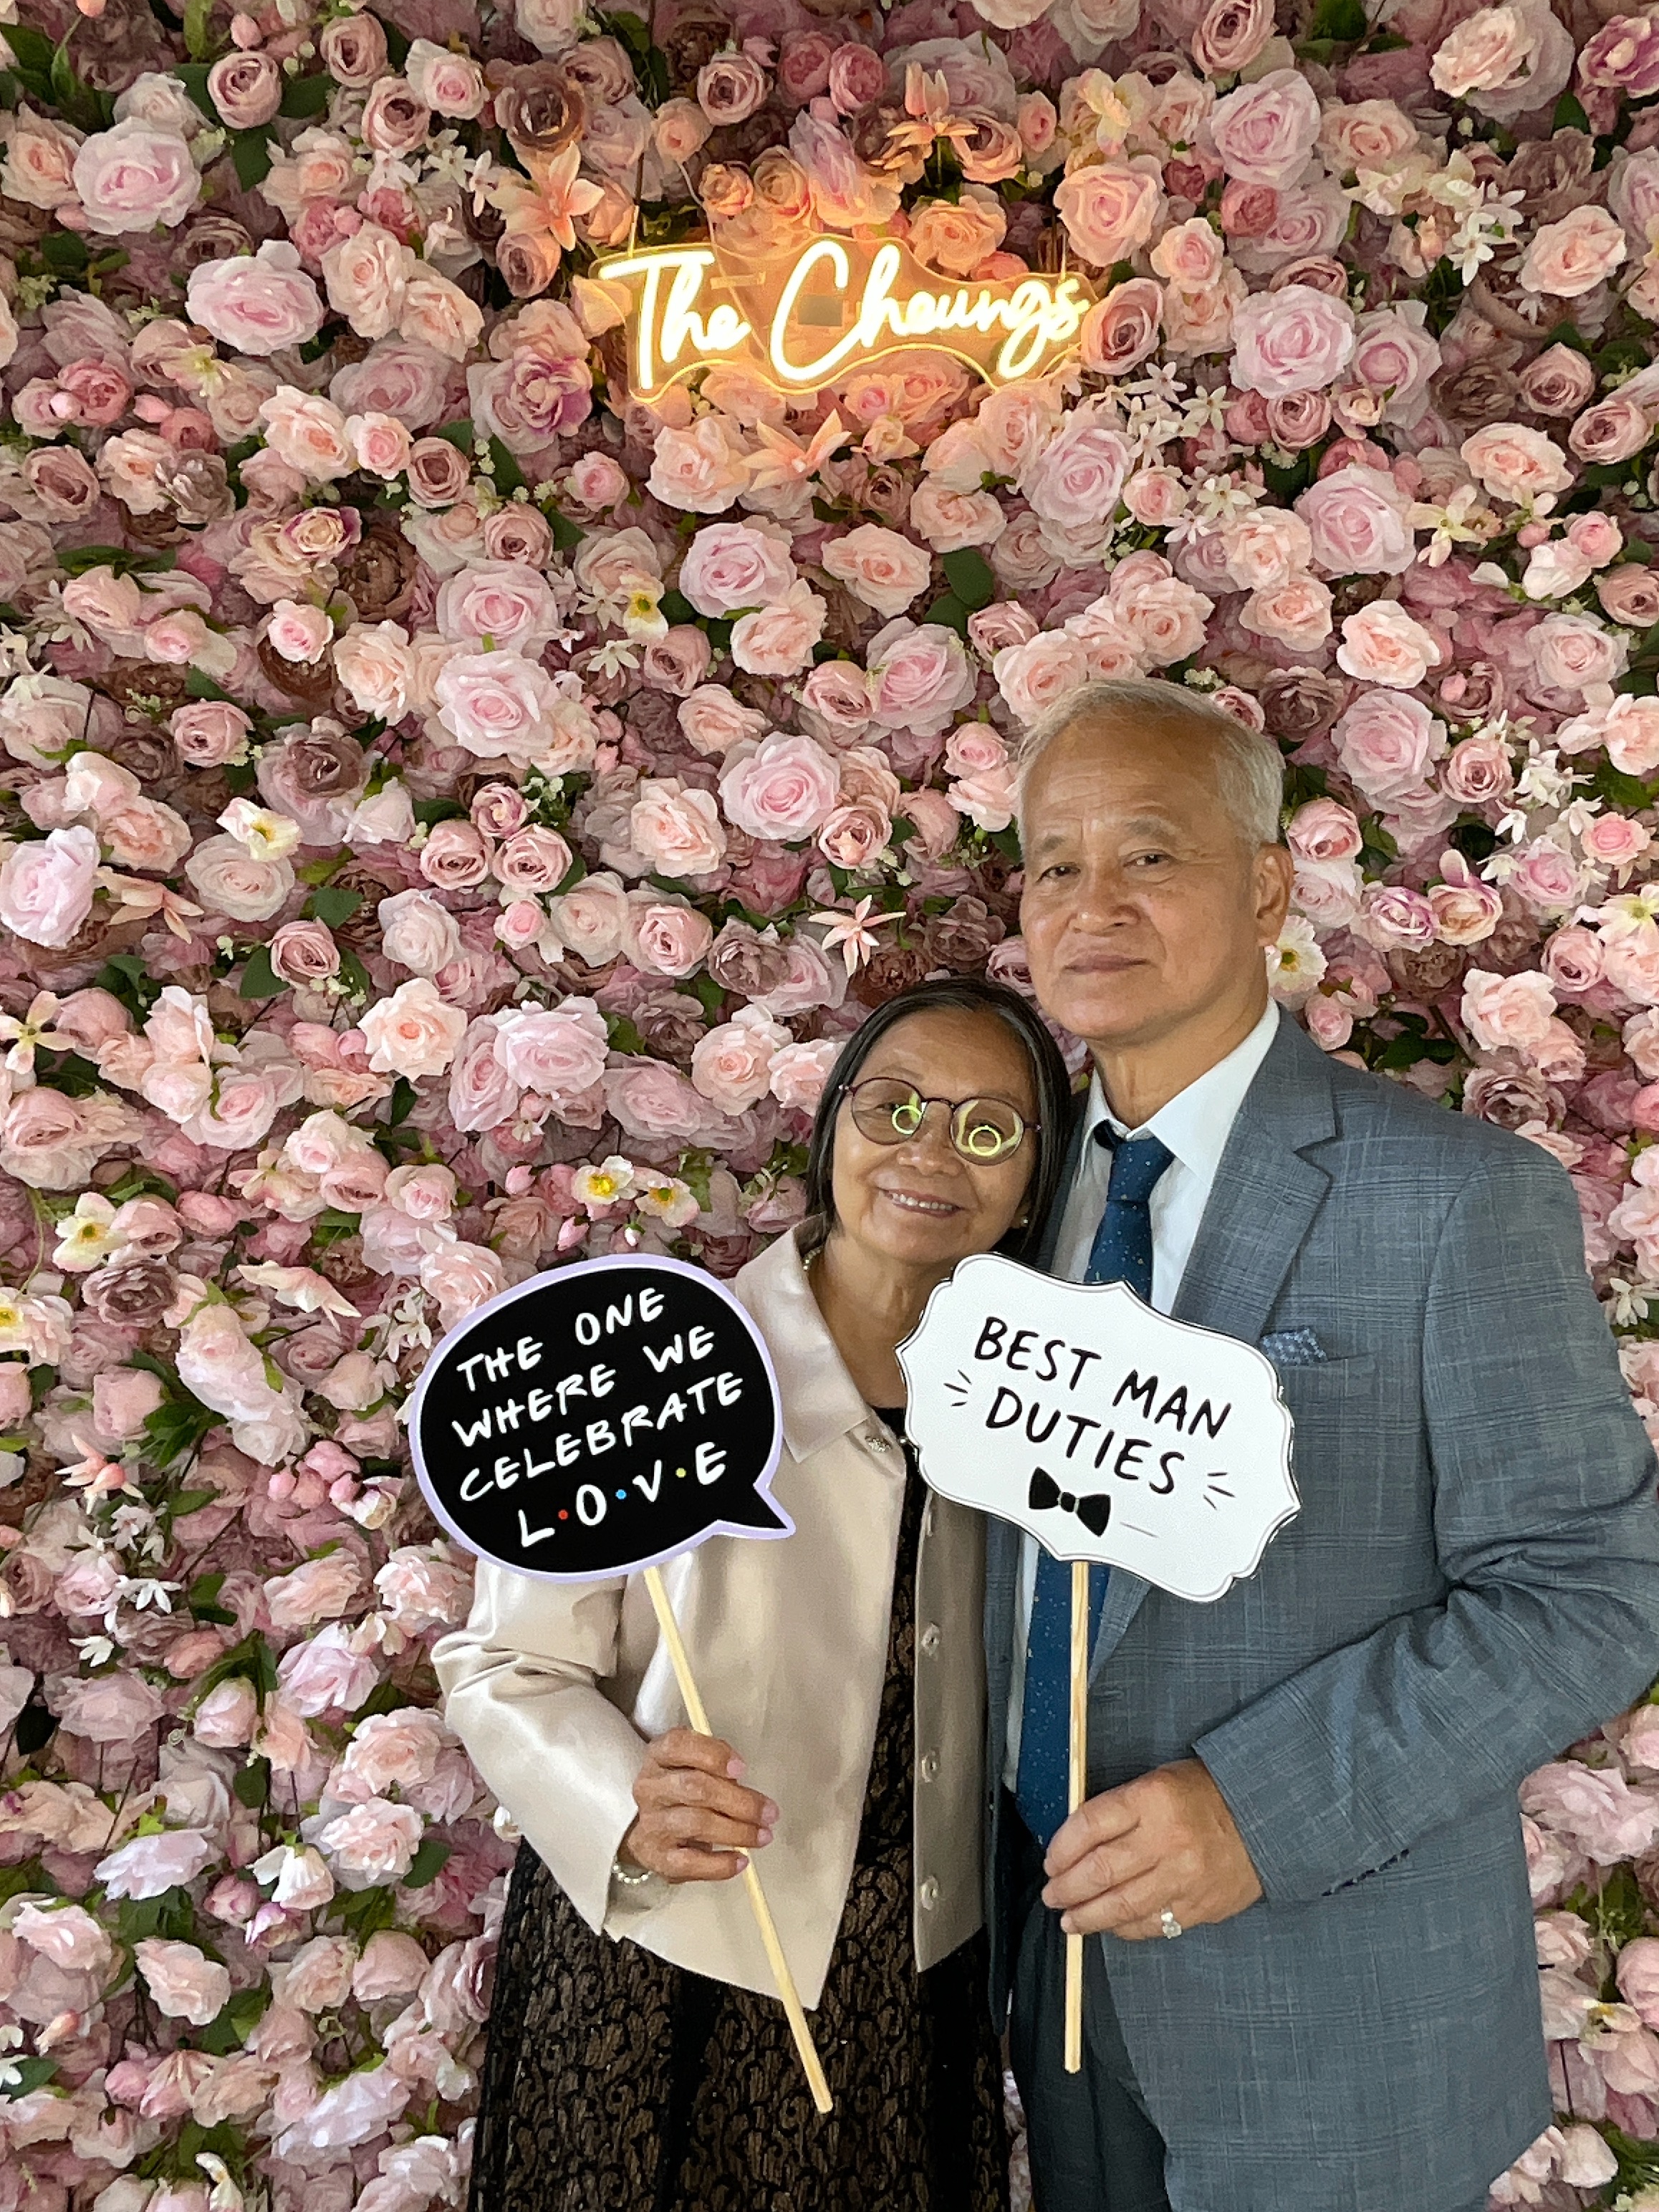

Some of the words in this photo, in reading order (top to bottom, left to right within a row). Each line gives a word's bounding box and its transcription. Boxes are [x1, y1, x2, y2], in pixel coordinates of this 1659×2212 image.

[599, 249, 749, 390] The
[769, 241, 1088, 380] Cheungs
[451, 1363, 617, 1448] WHERE
[642, 1325, 716, 1372] WE
[456, 1336, 543, 1392] THE
[574, 1287, 665, 1345] ONE
[973, 1316, 1102, 1390] BEST
[1112, 1369, 1231, 1439] MAN
[459, 1371, 744, 1501] CELEBRATE
[985, 1386, 1185, 1495] DUTIES
